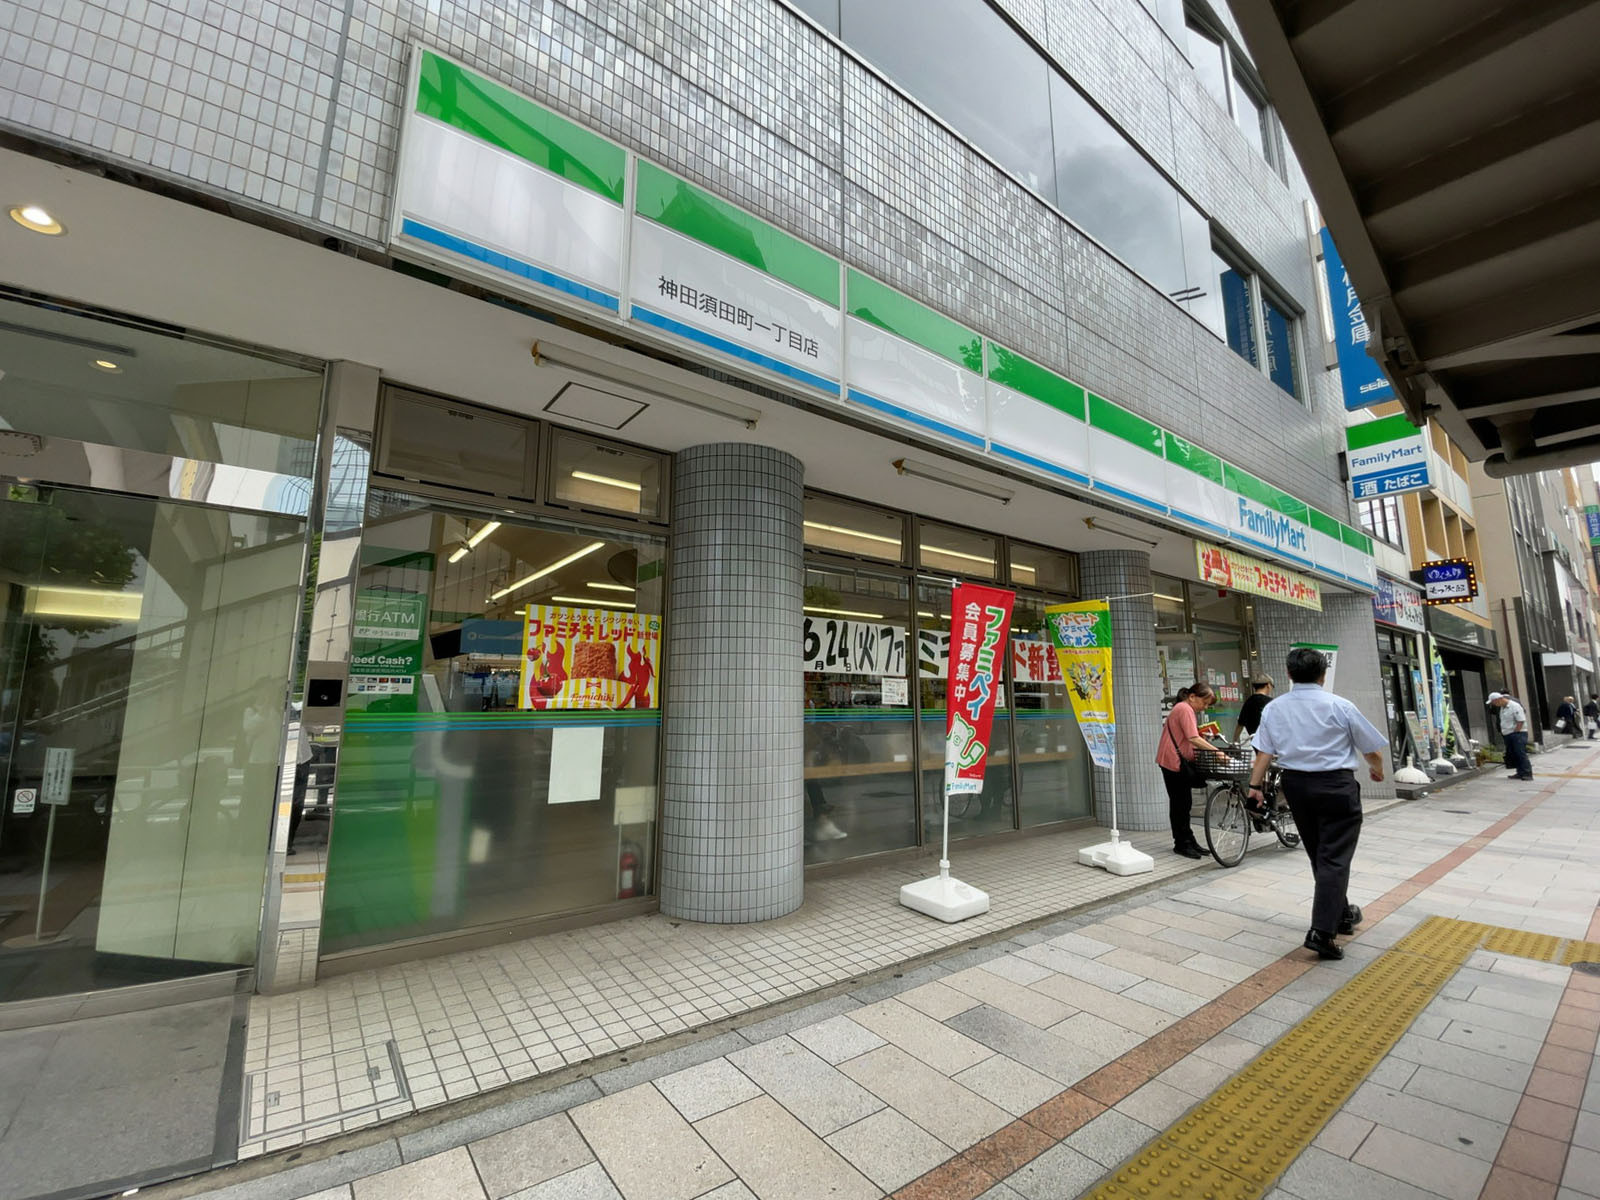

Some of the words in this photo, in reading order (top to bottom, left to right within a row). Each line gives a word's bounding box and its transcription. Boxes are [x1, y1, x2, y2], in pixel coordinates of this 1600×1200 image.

[658, 275, 819, 359] 神田須田町一丁目店
[1351, 444, 1423, 468] FamilyMart
[1360, 480, 1378, 496] 酒
[1384, 473, 1423, 491] たばこ
[1238, 496, 1307, 552] FamilyMart
[377, 655, 413, 665] Cash?
[954, 602, 981, 702] 会員募集中
[966, 605, 1006, 721] ファミペイ
